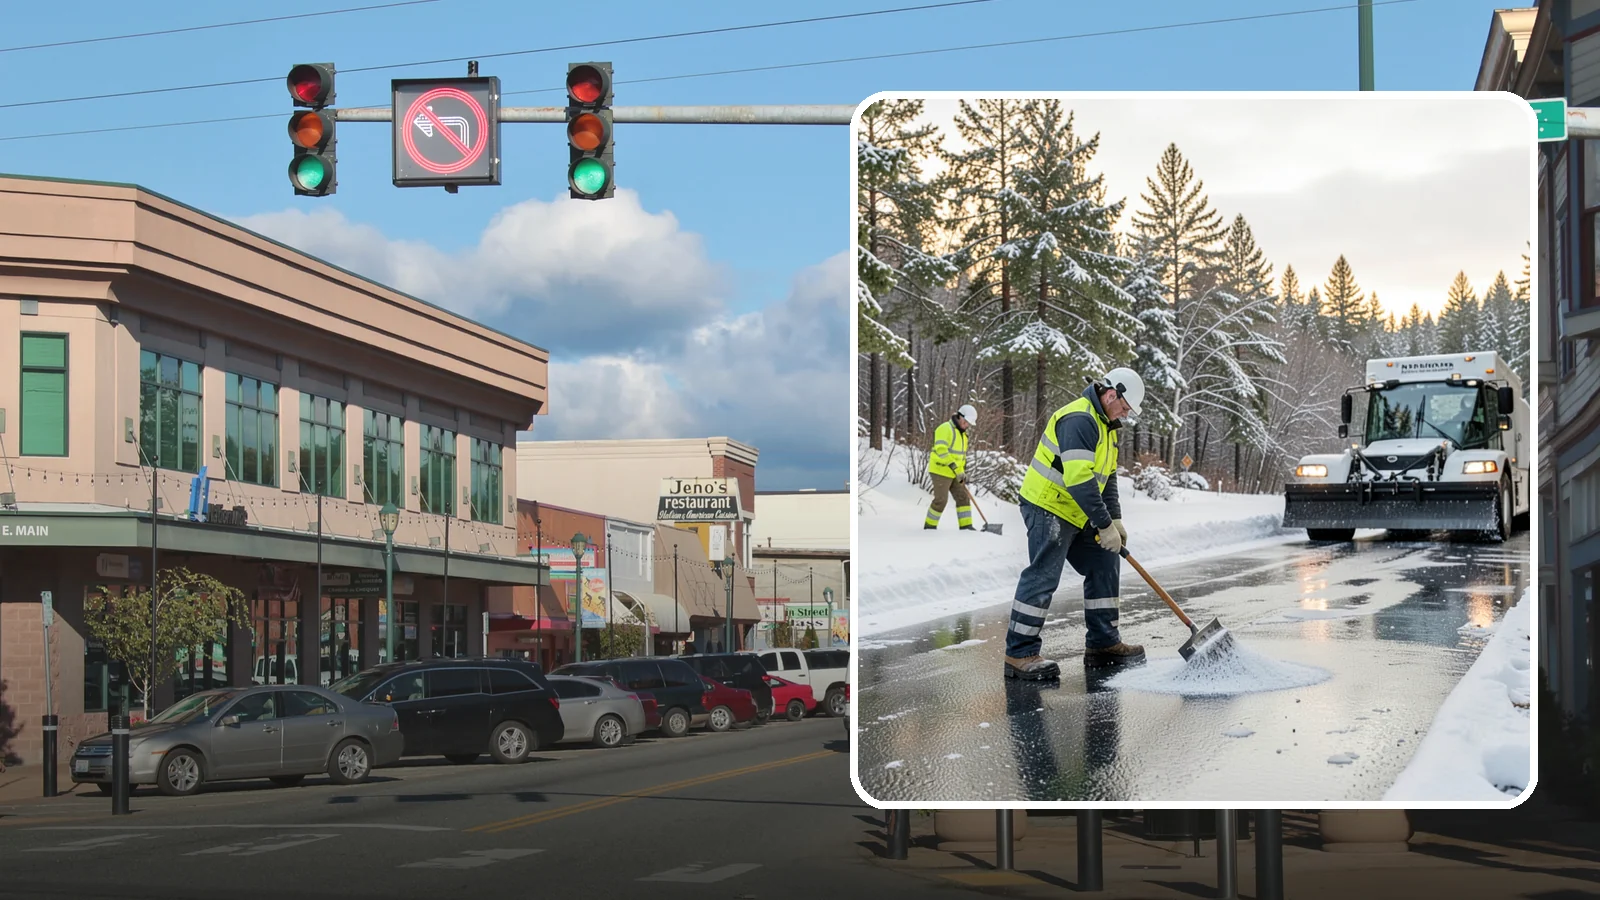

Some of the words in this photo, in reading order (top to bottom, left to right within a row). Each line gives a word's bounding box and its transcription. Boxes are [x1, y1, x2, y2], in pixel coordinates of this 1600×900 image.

[669, 480, 728, 495] Jeno's
[664, 496, 731, 509] restaurant
[658, 509, 681, 520] Italian
[685, 509, 715, 519] American
[714, 509, 738, 519] Cuisine
[2, 525, 13, 536] E.
[15, 525, 49, 536] MAIN
[797, 607, 829, 617] Street
[790, 619, 824, 628] lass
